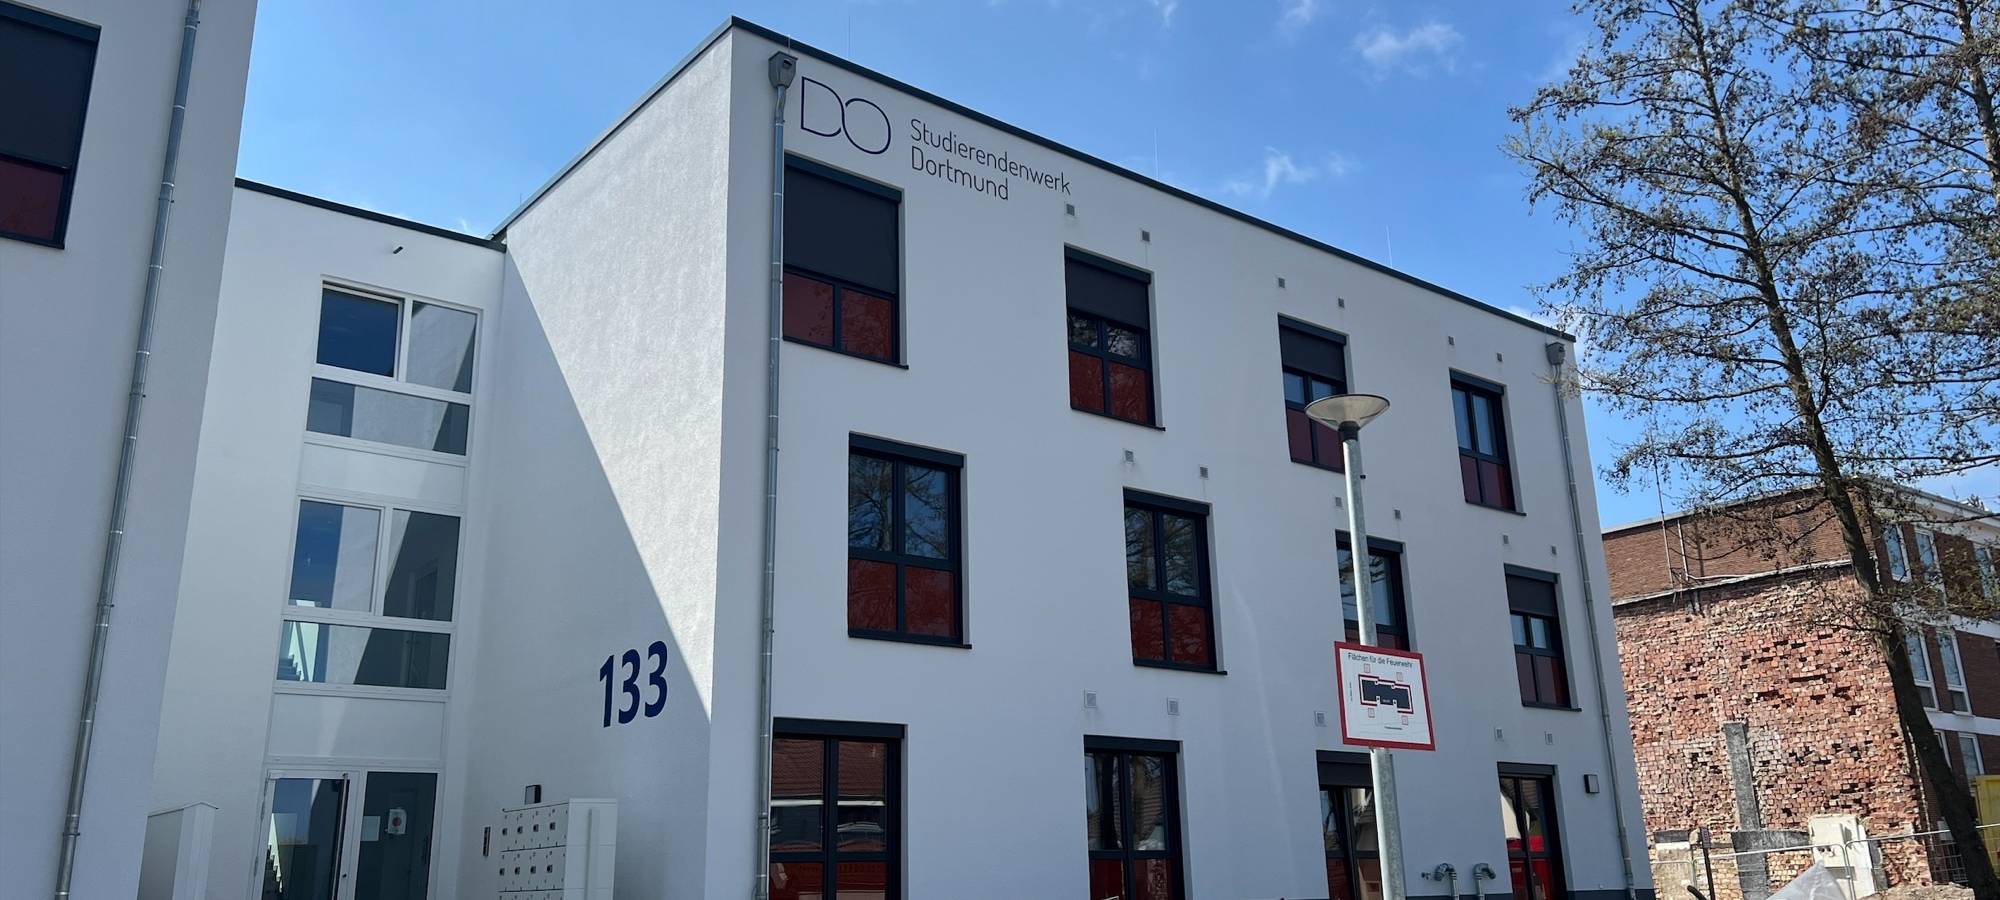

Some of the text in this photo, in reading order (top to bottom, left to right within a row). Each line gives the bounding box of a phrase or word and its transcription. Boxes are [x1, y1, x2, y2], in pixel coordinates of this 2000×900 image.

[801, 76, 891, 154] DO
[911, 118, 1071, 195] Studierendenwerk
[911, 146, 1009, 201] Dortmund
[600, 641, 667, 728] 133
[1348, 652, 1368, 661] Flächen
[1386, 658, 1413, 668] Feuerwehr
